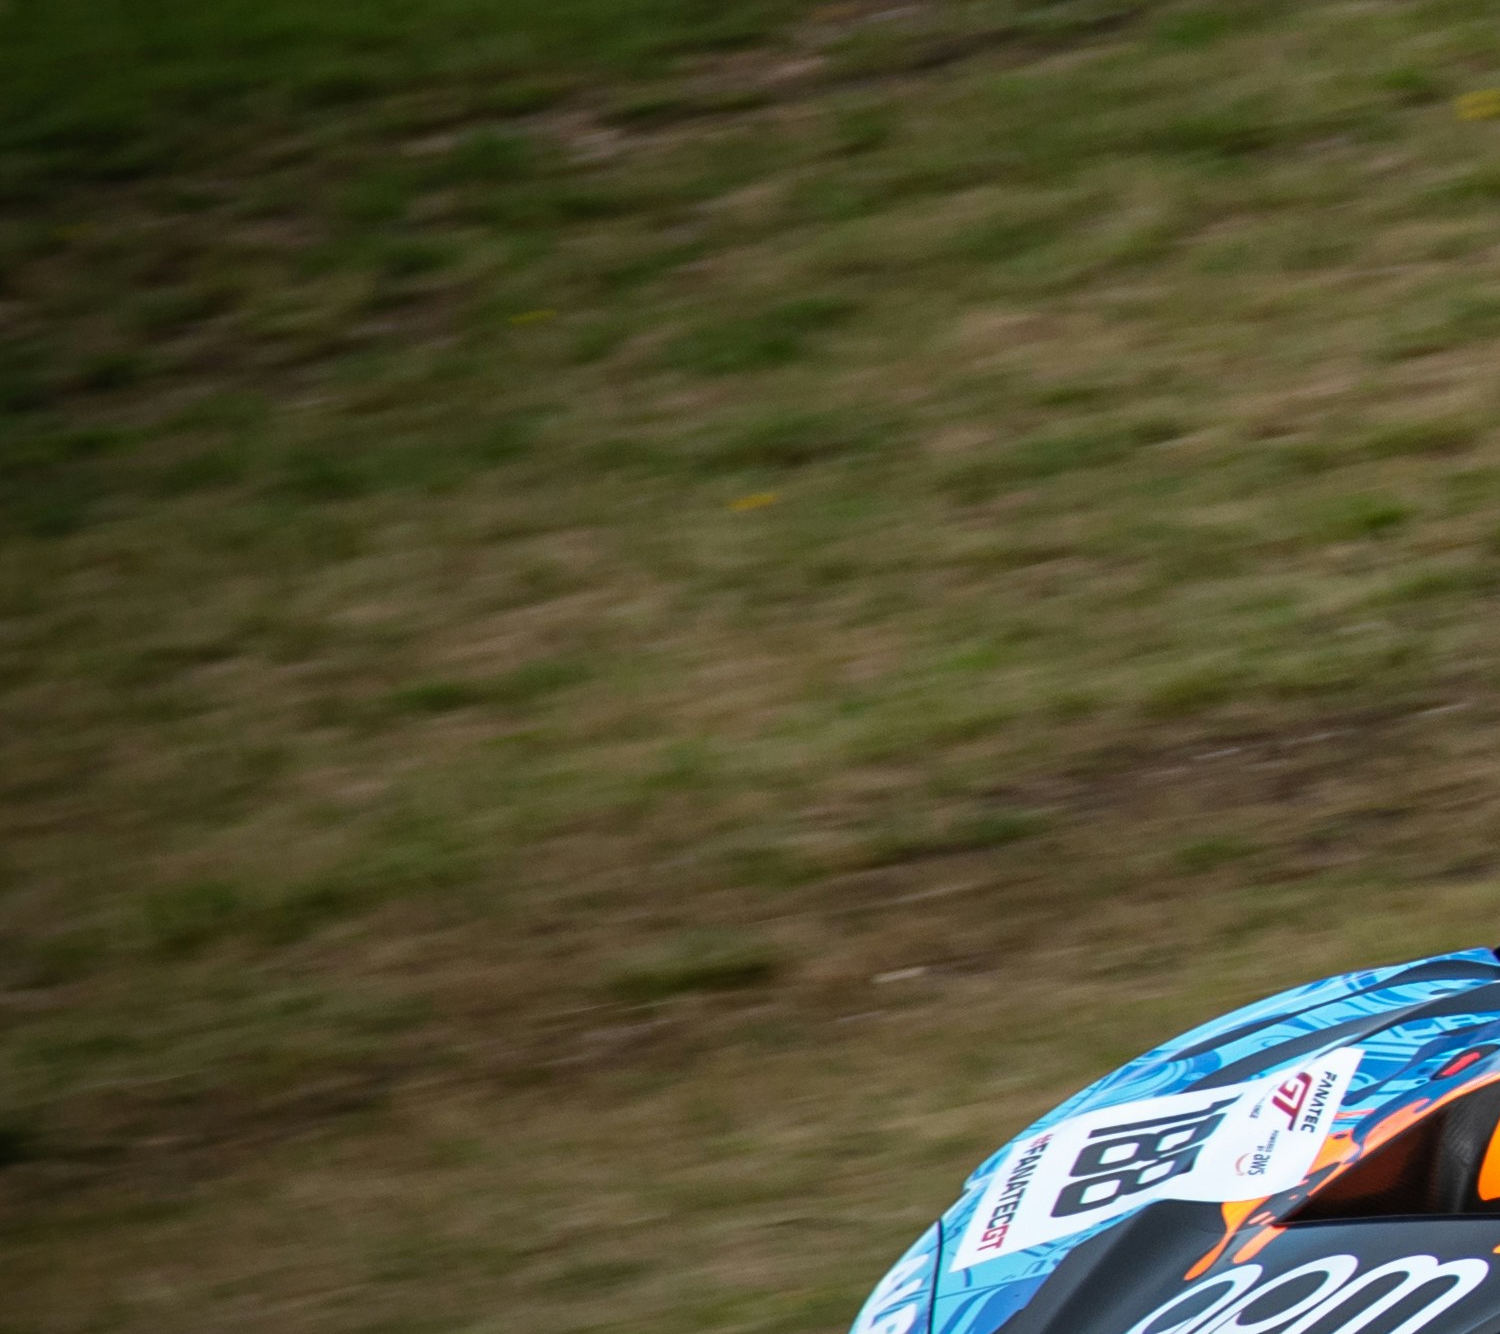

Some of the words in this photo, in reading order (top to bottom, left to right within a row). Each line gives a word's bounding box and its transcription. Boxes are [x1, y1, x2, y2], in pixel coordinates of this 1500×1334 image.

[1300, 1071, 1338, 1133] FANATEC
[1050, 1093, 1244, 1218] 188
[1248, 1149, 1270, 1175] aws
